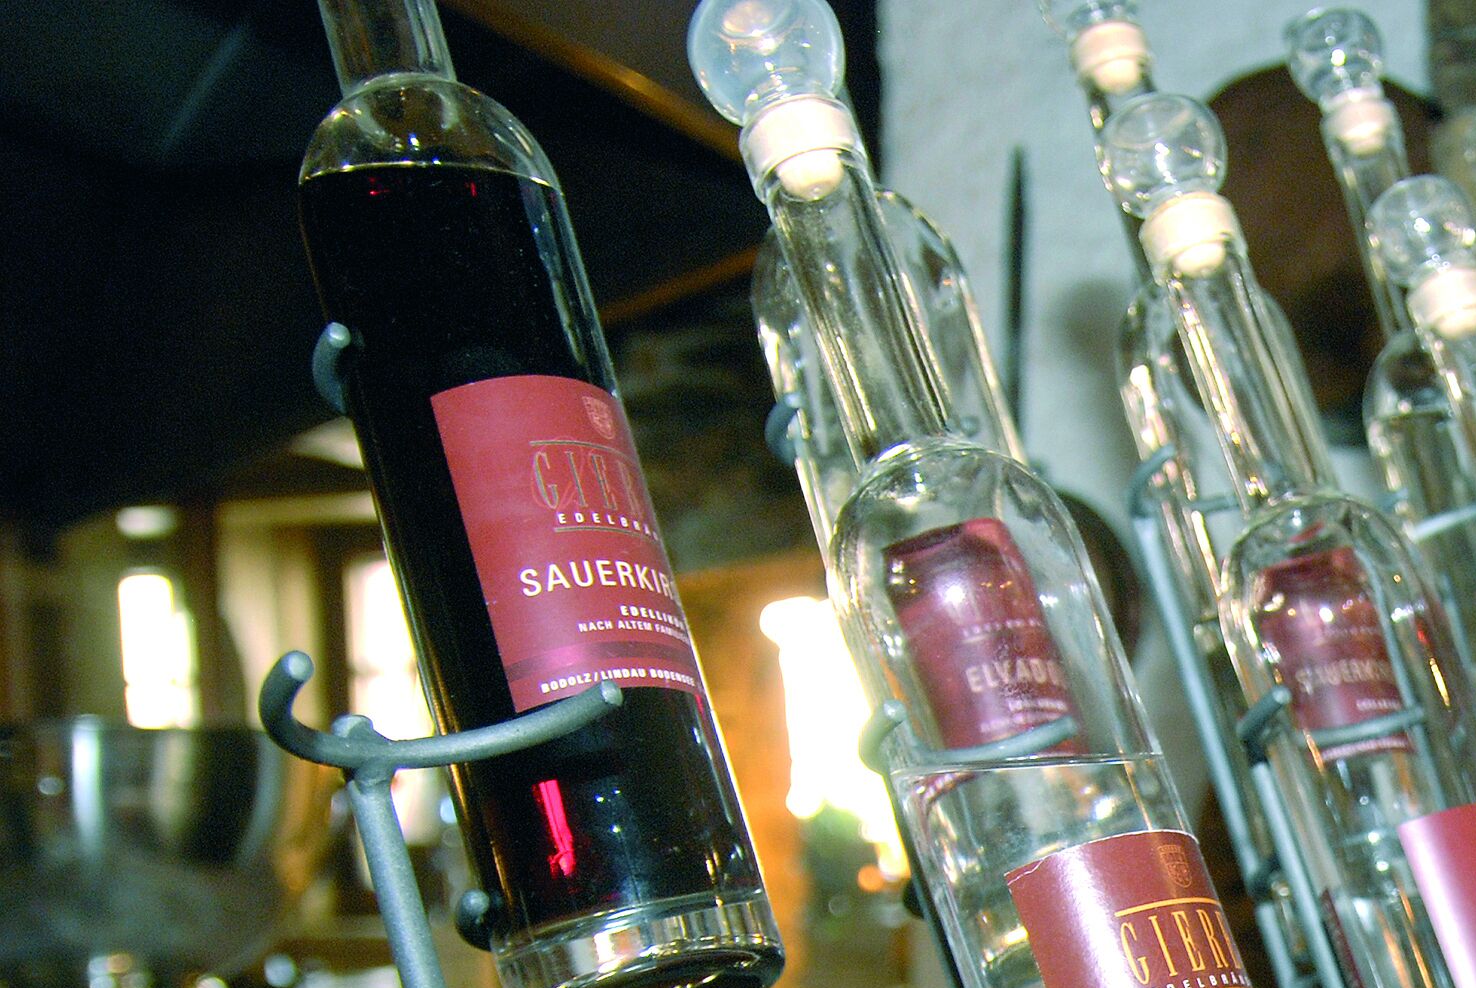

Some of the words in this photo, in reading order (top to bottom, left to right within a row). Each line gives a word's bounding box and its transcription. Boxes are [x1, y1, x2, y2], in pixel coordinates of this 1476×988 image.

[519, 559, 678, 599] SAUERKIR
[577, 620, 613, 632] NACH
[617, 620, 653, 631] ALTEM
[649, 667, 695, 686] BODENSEE
